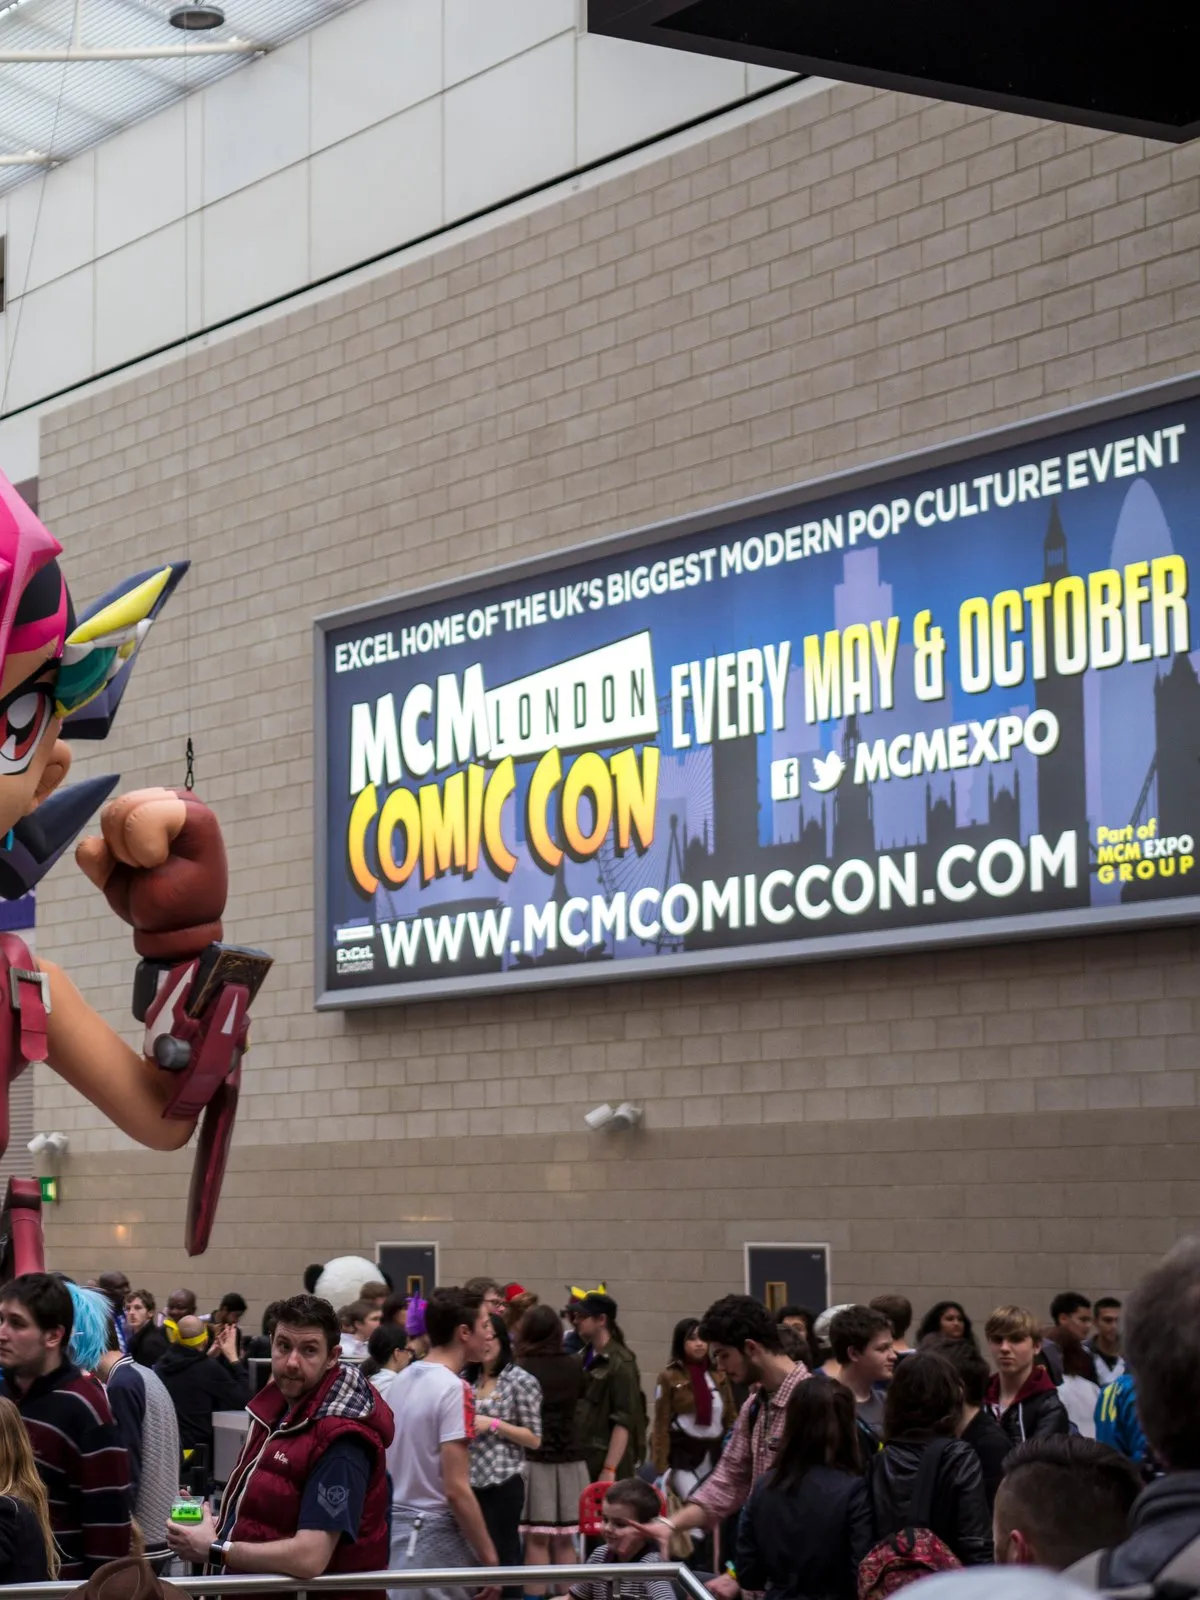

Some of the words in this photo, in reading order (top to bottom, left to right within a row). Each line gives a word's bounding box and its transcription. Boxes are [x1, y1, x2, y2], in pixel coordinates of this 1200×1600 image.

[335, 631, 400, 673] EXCEL
[401, 613, 465, 657] HOME
[466, 603, 499, 640] OF
[500, 592, 547, 631] THE
[549, 578, 603, 620] UK'S
[607, 548, 716, 606] BIGGEST
[721, 514, 844, 578] MODERN
[848, 498, 910, 546] POP
[914, 456, 1062, 527] CULTURE
[1066, 424, 1186, 490] EVENT
[670, 641, 791, 749] EVERY
[803, 616, 899, 724] MAY
[913, 609, 946, 702] &
[959, 554, 1190, 694] OCTOBER
[350, 662, 492, 795] MCM
[496, 668, 645, 745] LONDON
[853, 708, 1059, 784] MCMEXPO
[349, 754, 518, 894] COMIC
[528, 745, 660, 867] CON
[1097, 824, 1134, 845] Part
[1136, 817, 1157, 840] of
[1097, 841, 1141, 865] MCM
[1144, 834, 1194, 858] EXPO
[1097, 855, 1194, 884] GROUP
[381, 830, 1078, 968] WWW.MCMCOMICCON.COM
